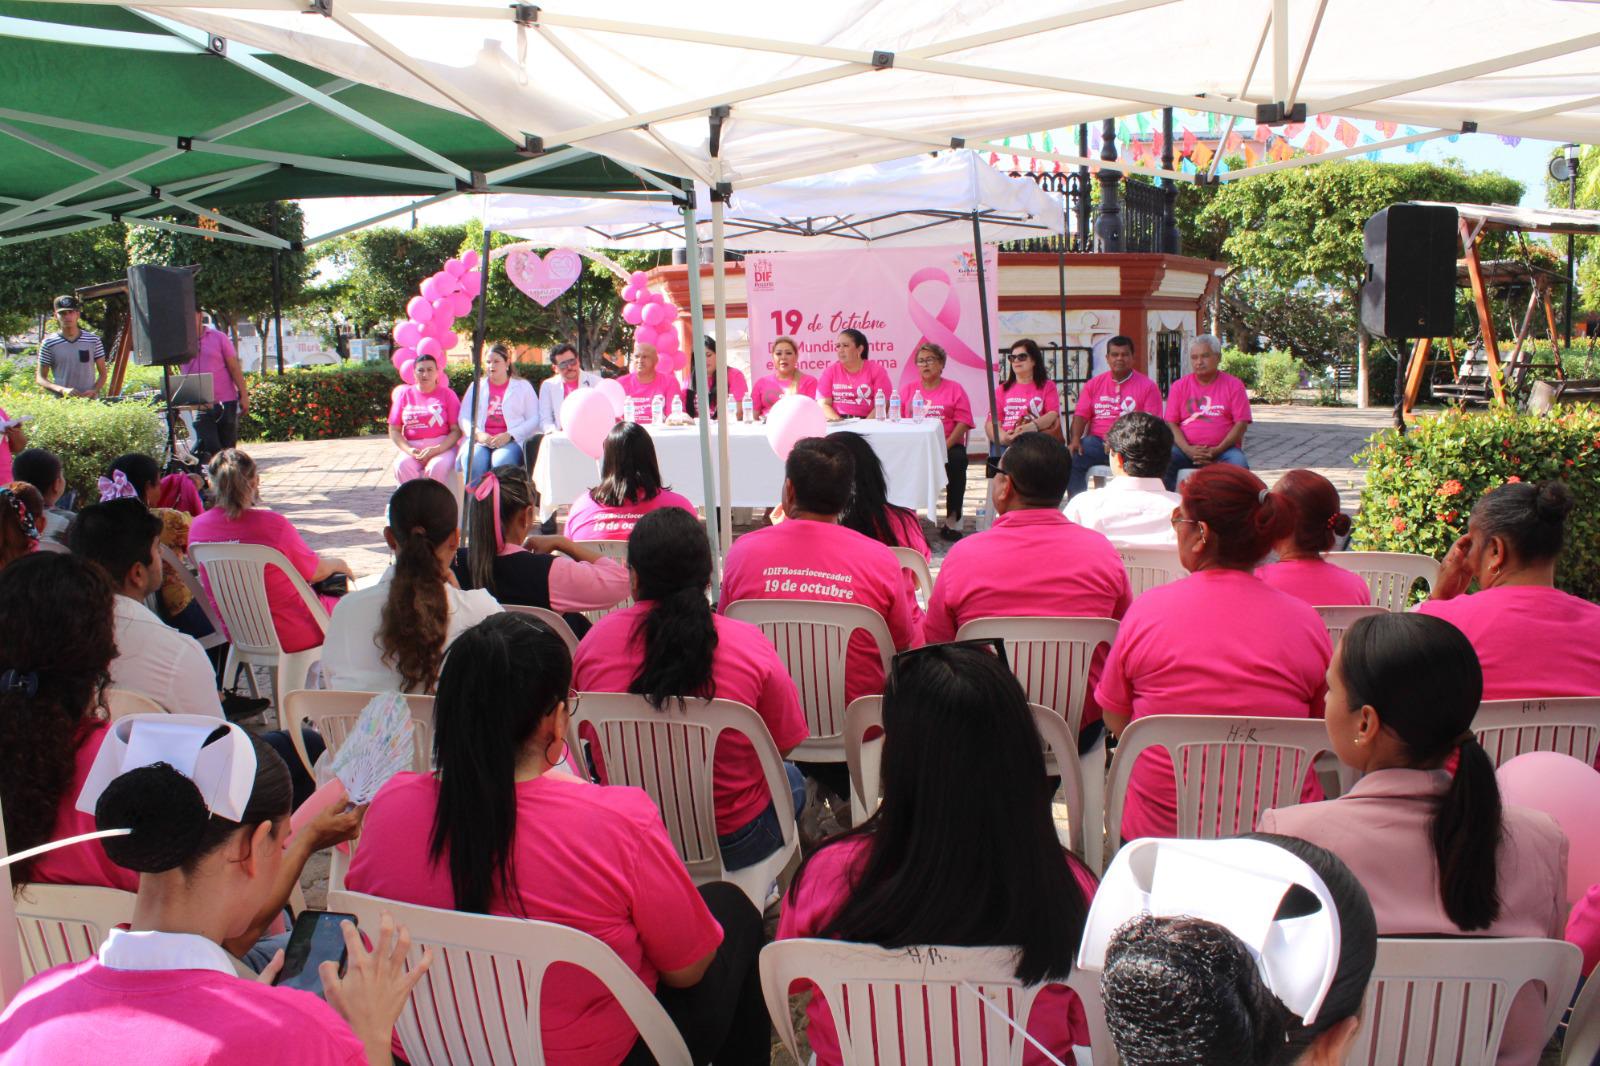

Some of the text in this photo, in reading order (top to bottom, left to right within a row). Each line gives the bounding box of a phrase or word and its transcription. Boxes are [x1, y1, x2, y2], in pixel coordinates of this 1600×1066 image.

[754, 271, 772, 282] DIF
[770, 309, 887, 336] 19 de Octubre
[798, 340, 839, 353] Mundia
[606, 520, 619, 531] de
[764, 579, 854, 600] 19 de octubre
